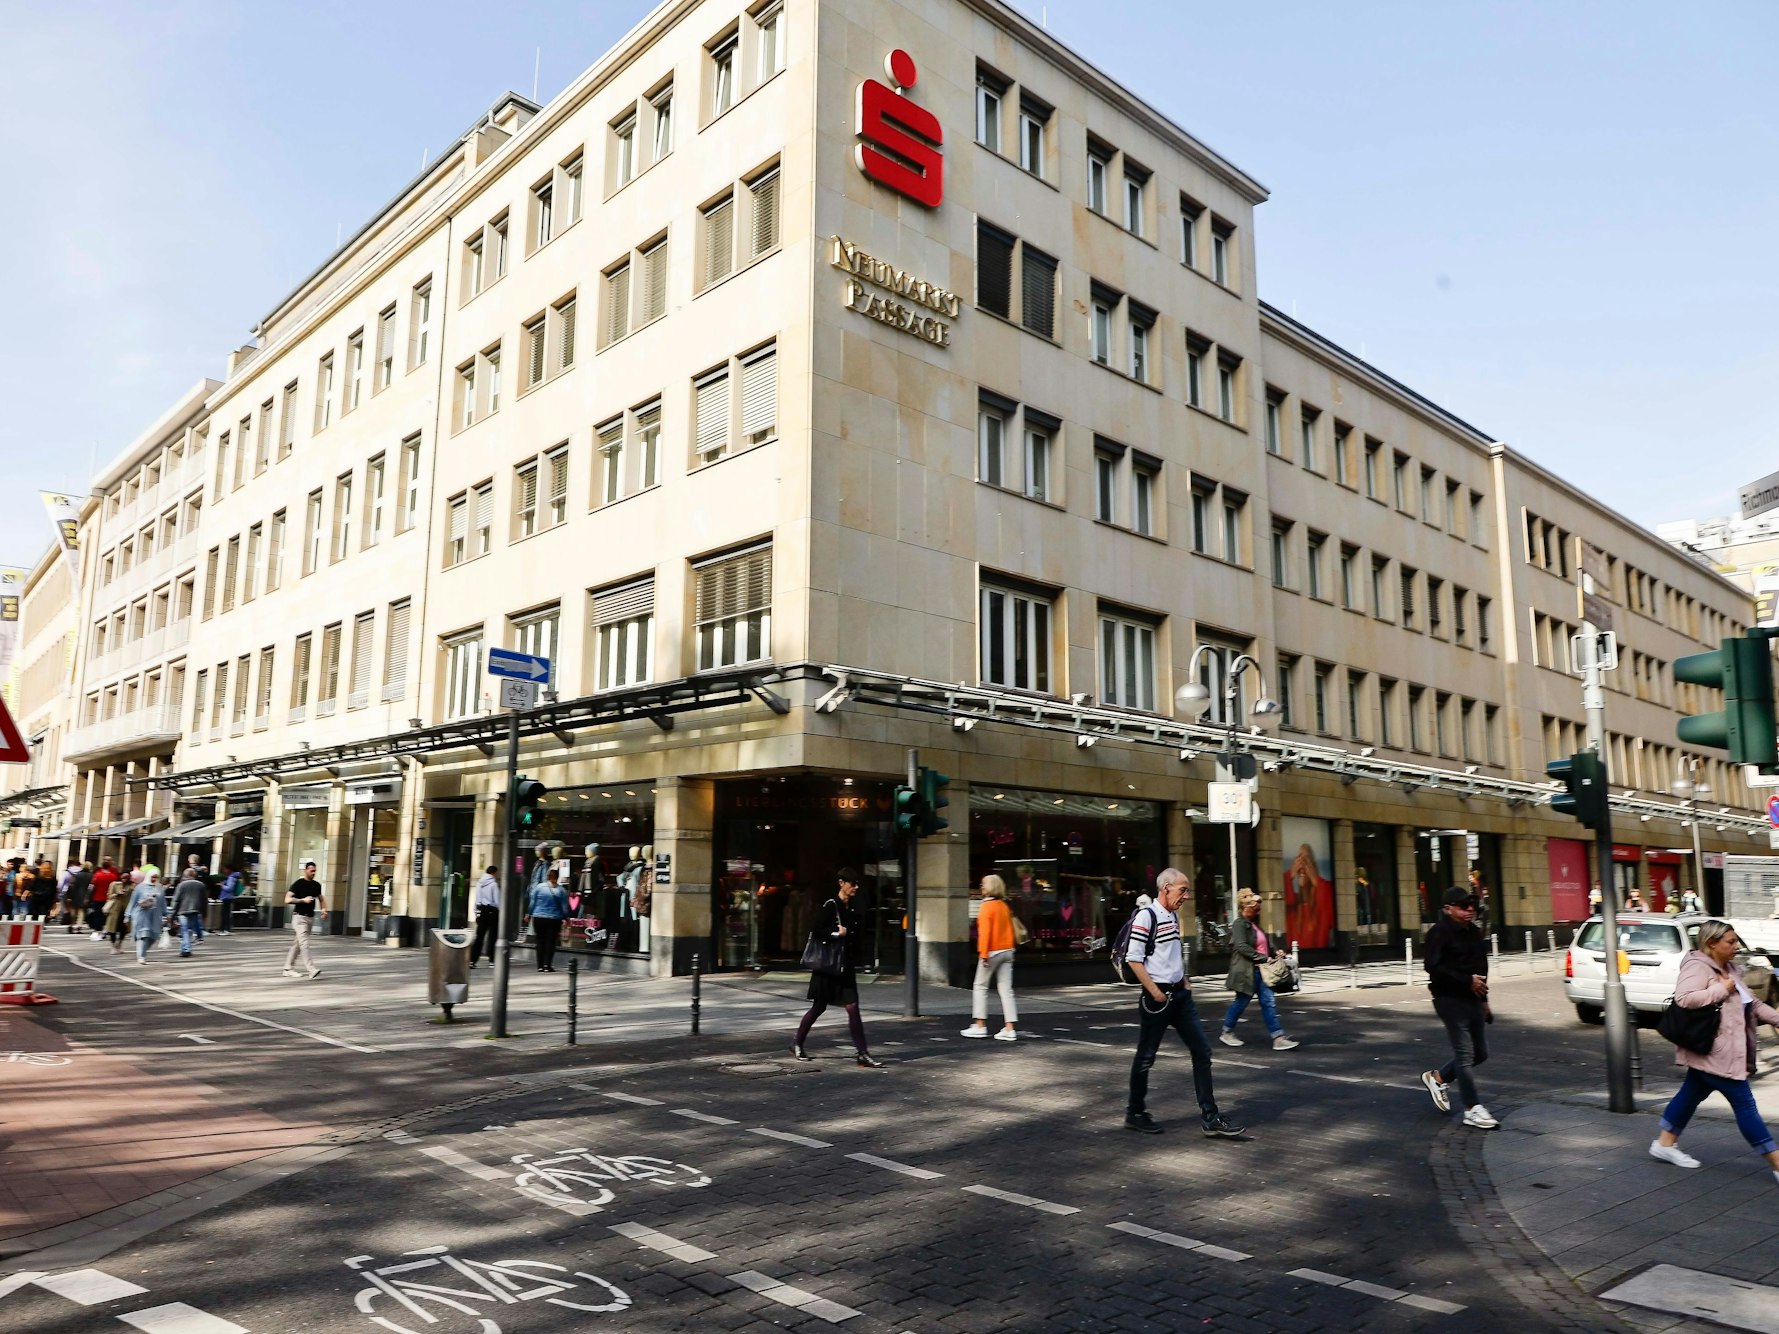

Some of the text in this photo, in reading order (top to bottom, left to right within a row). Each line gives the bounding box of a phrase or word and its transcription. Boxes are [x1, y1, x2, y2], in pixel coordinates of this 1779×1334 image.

[831, 234, 963, 319] NEUMARKT
[844, 278, 951, 348] PASSAGE
[1223, 792, 1238, 804] 30
